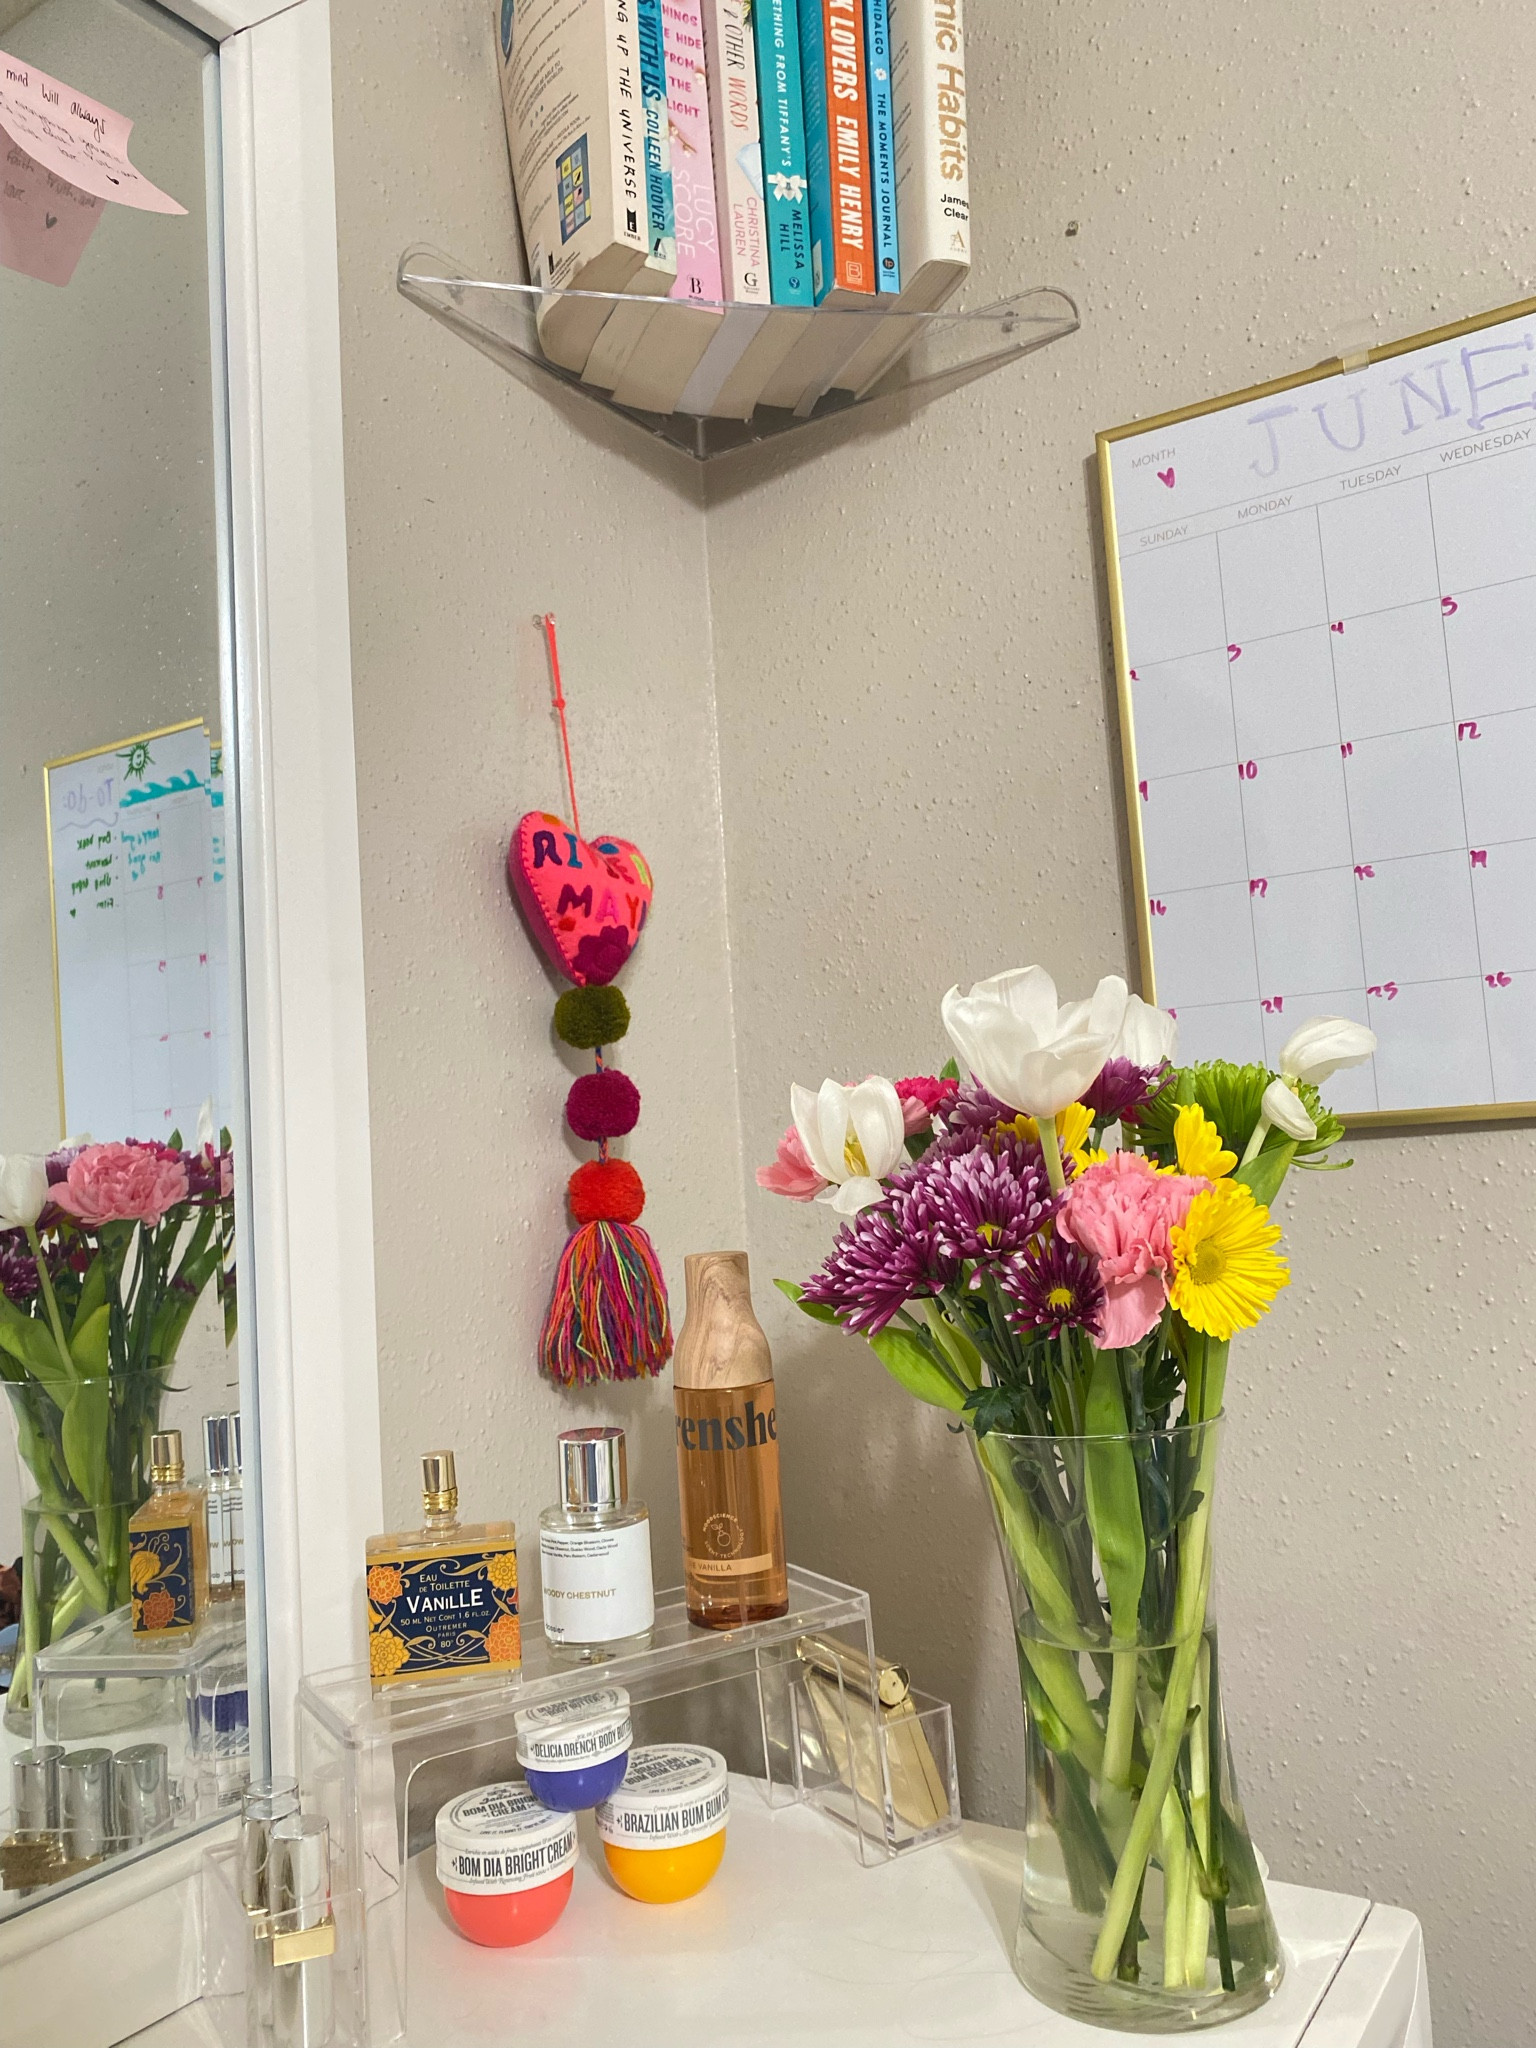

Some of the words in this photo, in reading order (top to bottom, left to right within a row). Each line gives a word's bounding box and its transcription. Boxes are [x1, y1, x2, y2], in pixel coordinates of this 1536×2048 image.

[617, 34, 629, 56] UP
[638, 14, 659, 69] WITH
[675, 32, 702, 50] HIDE
[724, 24, 745, 70] OTHER
[873, 0, 884, 55] HIDALGO
[664, 50, 695, 69] FROM
[775, 54, 787, 93] FROM
[830, 16, 858, 102] LOVERS
[619, 67, 632, 99] THE
[640, 71, 661, 101] US
[668, 76, 692, 93] THE
[728, 77, 748, 131] WORDS
[667, 98, 700, 118] LIGHT
[877, 93, 887, 117] THE
[936, 63, 968, 182] Habits
[619, 109, 637, 199] UNIVERSE
[646, 109, 662, 172] COLLEEN
[778, 98, 792, 167] TIFFANY'S
[836, 115, 861, 179] EMILY
[878, 121, 890, 184] MOMENTS
[650, 174, 665, 231] HOOVER
[672, 166, 696, 259] SCORE
[693, 184, 716, 254] LUCY
[839, 184, 864, 250] HENRY
[881, 189, 892, 248] JOURNAL
[944, 208, 968, 222] Clear
[733, 203, 747, 257] LAUREN
[746, 197, 760, 267] CHRISTINA
[779, 223, 790, 252] HILL
[791, 209, 805, 269] MELISSA
[1247, 333, 1536, 478] JUNE
[1131, 446, 1177, 469] MONTH
[1139, 524, 1189, 547] SUNDAY
[1237, 495, 1293, 520] MONDAY
[1339, 464, 1402, 491] TUESDAY
[1439, 428, 1532, 463] WEDNESDAY
[1238, 760, 1258, 779] 10
[1340, 741, 1353, 758] 11
[1457, 721, 1481, 741] 12
[1149, 899, 1167, 916] 16
[419, 1574, 438, 1583] EAU
[430, 1580, 470, 1592] TOILETTE
[697, 1562, 732, 1572] VANILLA
[406, 1588, 484, 1614] VANILLE
[566, 1588, 616, 1600] CHESTNUT
[425, 1622, 467, 1633] OUTREMER
[534, 1743, 563, 1758] DELICIA
[564, 1737, 597, 1757] DRENCH
[598, 1730, 616, 1748] BODY
[462, 1805, 487, 1817] BOM
[488, 1801, 506, 1812] DIA
[491, 1805, 527, 1818] CREAM
[624, 1812, 679, 1833] BRAZILIAN
[682, 1804, 705, 1829] BUM
[706, 1793, 722, 1820] BUM
[458, 1855, 481, 1877] BOM
[484, 1857, 502, 1877] DIA
[505, 1847, 548, 1875] BRIGHT
[547, 1831, 573, 1864] CREAM
